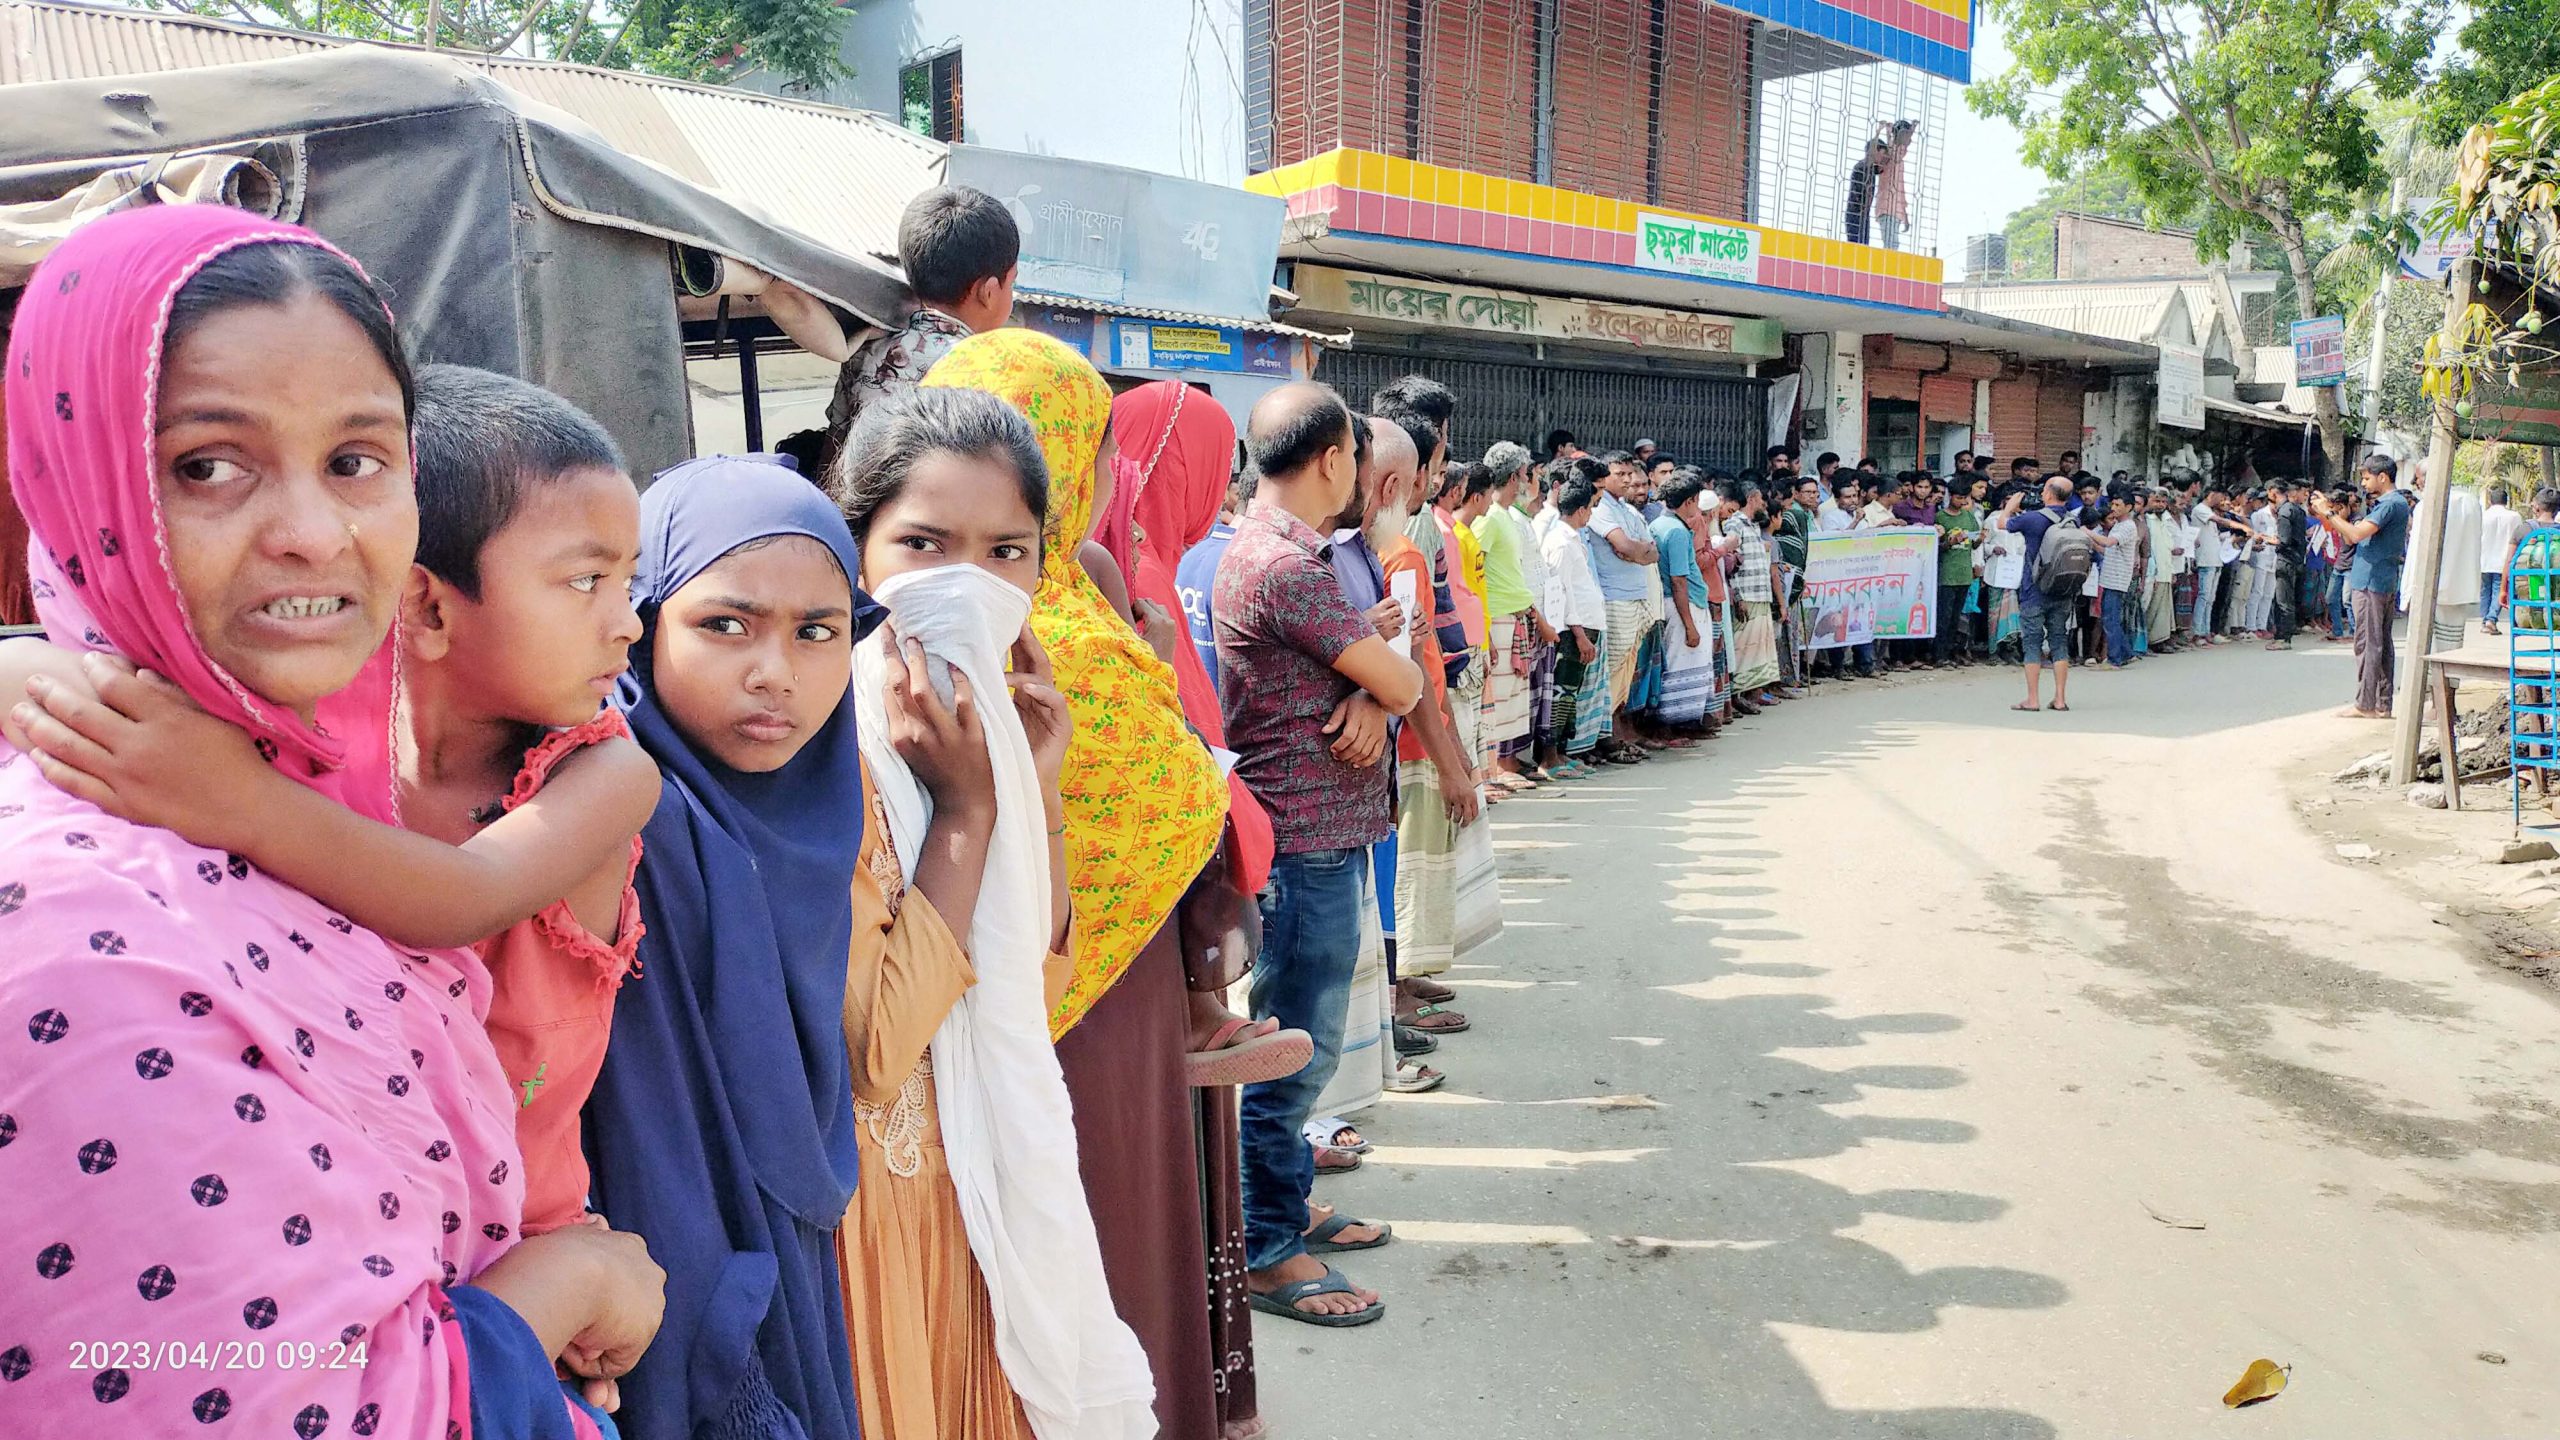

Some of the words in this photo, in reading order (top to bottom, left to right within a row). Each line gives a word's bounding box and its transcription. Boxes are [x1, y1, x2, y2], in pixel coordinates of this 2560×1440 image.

[1176, 220, 1221, 252] 4G
[1698, 228, 1749, 262] মার্কেট
[1346, 277, 1452, 321] মায়ের
[1456, 290, 1540, 331] দোয়া
